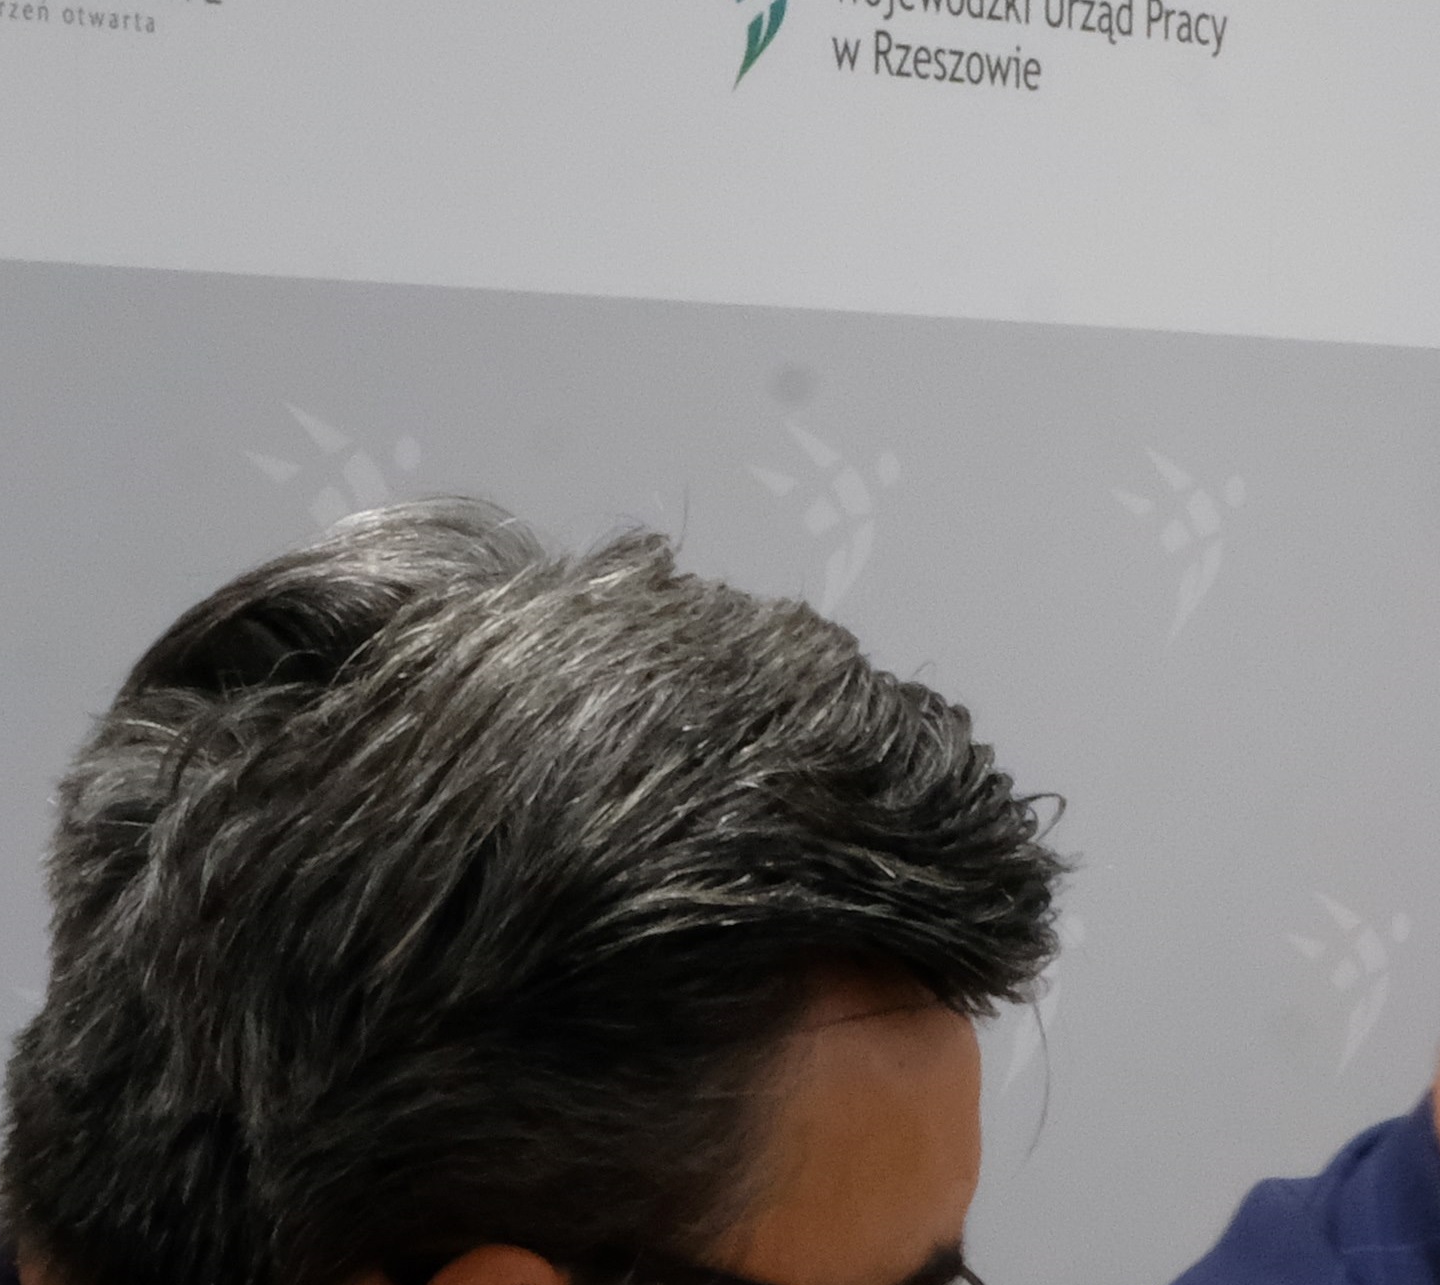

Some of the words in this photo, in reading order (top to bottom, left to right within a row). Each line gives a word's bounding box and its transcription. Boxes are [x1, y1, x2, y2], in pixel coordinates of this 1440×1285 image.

[62, 7, 156, 33] otwarta
[1045, 0, 1133, 45] Urząd
[1146, 0, 1227, 58] Pracy
[832, 36, 860, 71] w
[874, 30, 1042, 91] Rzeszowie
